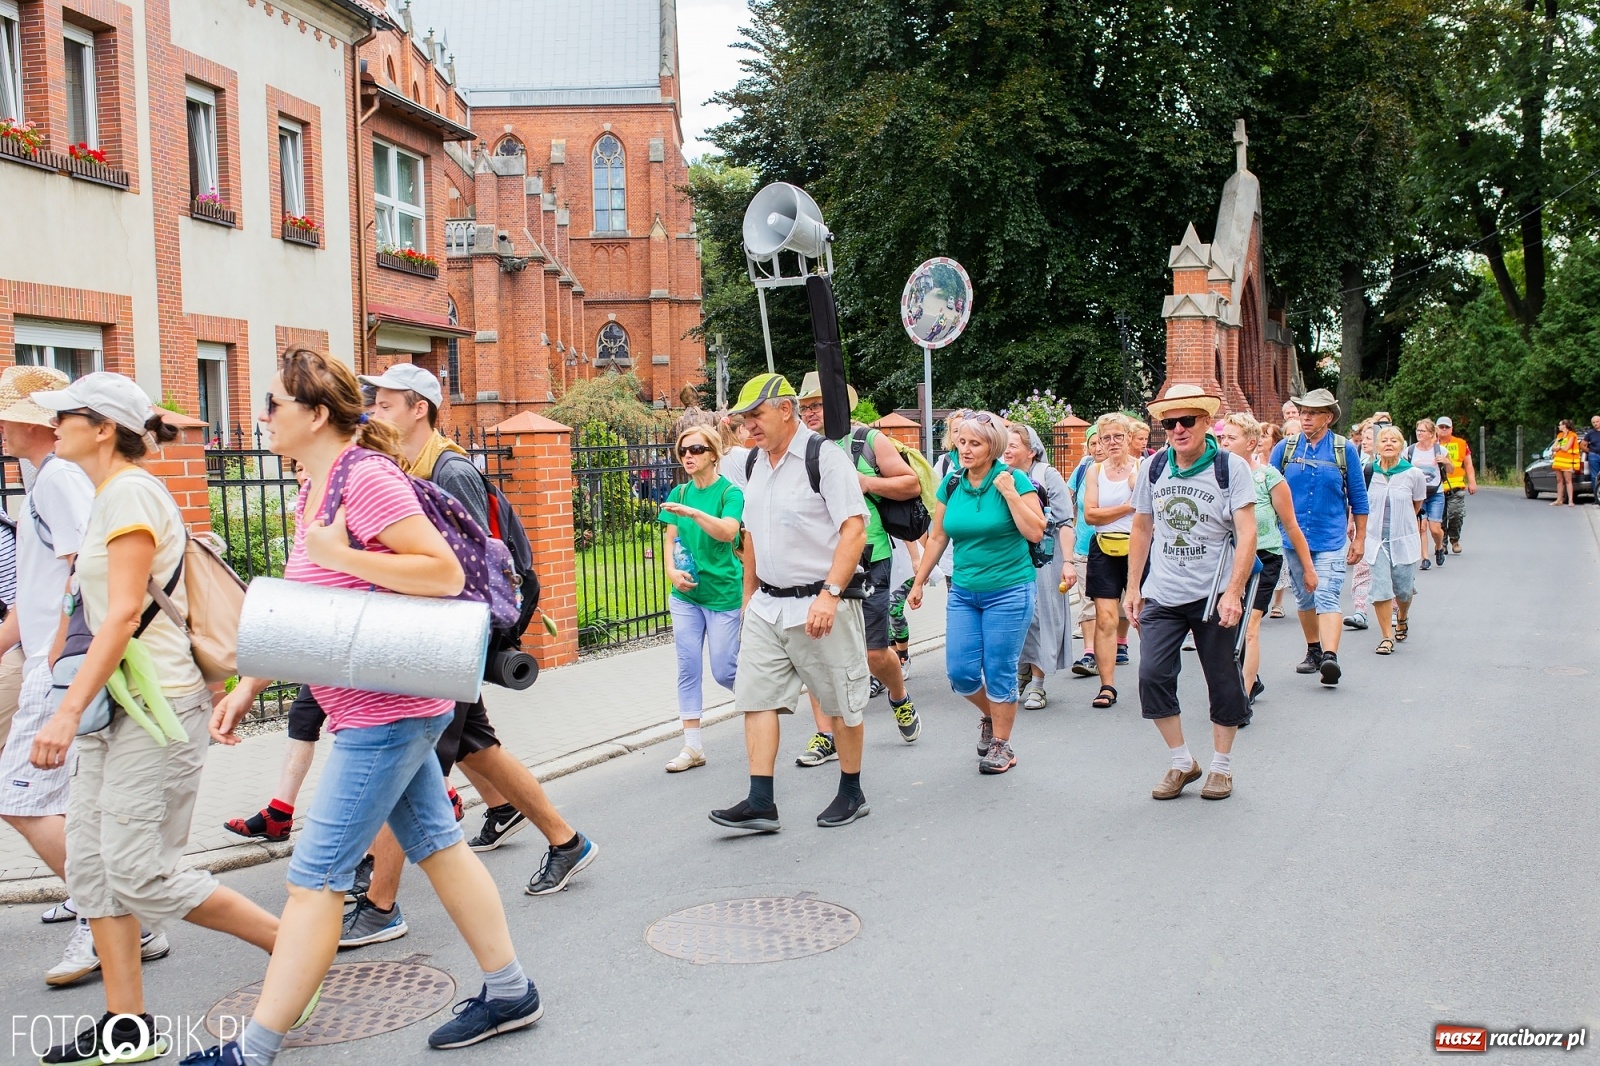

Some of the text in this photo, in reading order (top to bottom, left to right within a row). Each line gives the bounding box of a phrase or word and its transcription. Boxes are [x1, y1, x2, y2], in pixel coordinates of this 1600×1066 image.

[1154, 485, 1215, 503] GLOBETROTTER
[1199, 514, 1209, 523] 81
[1163, 542, 1207, 556] ADVENTURE
